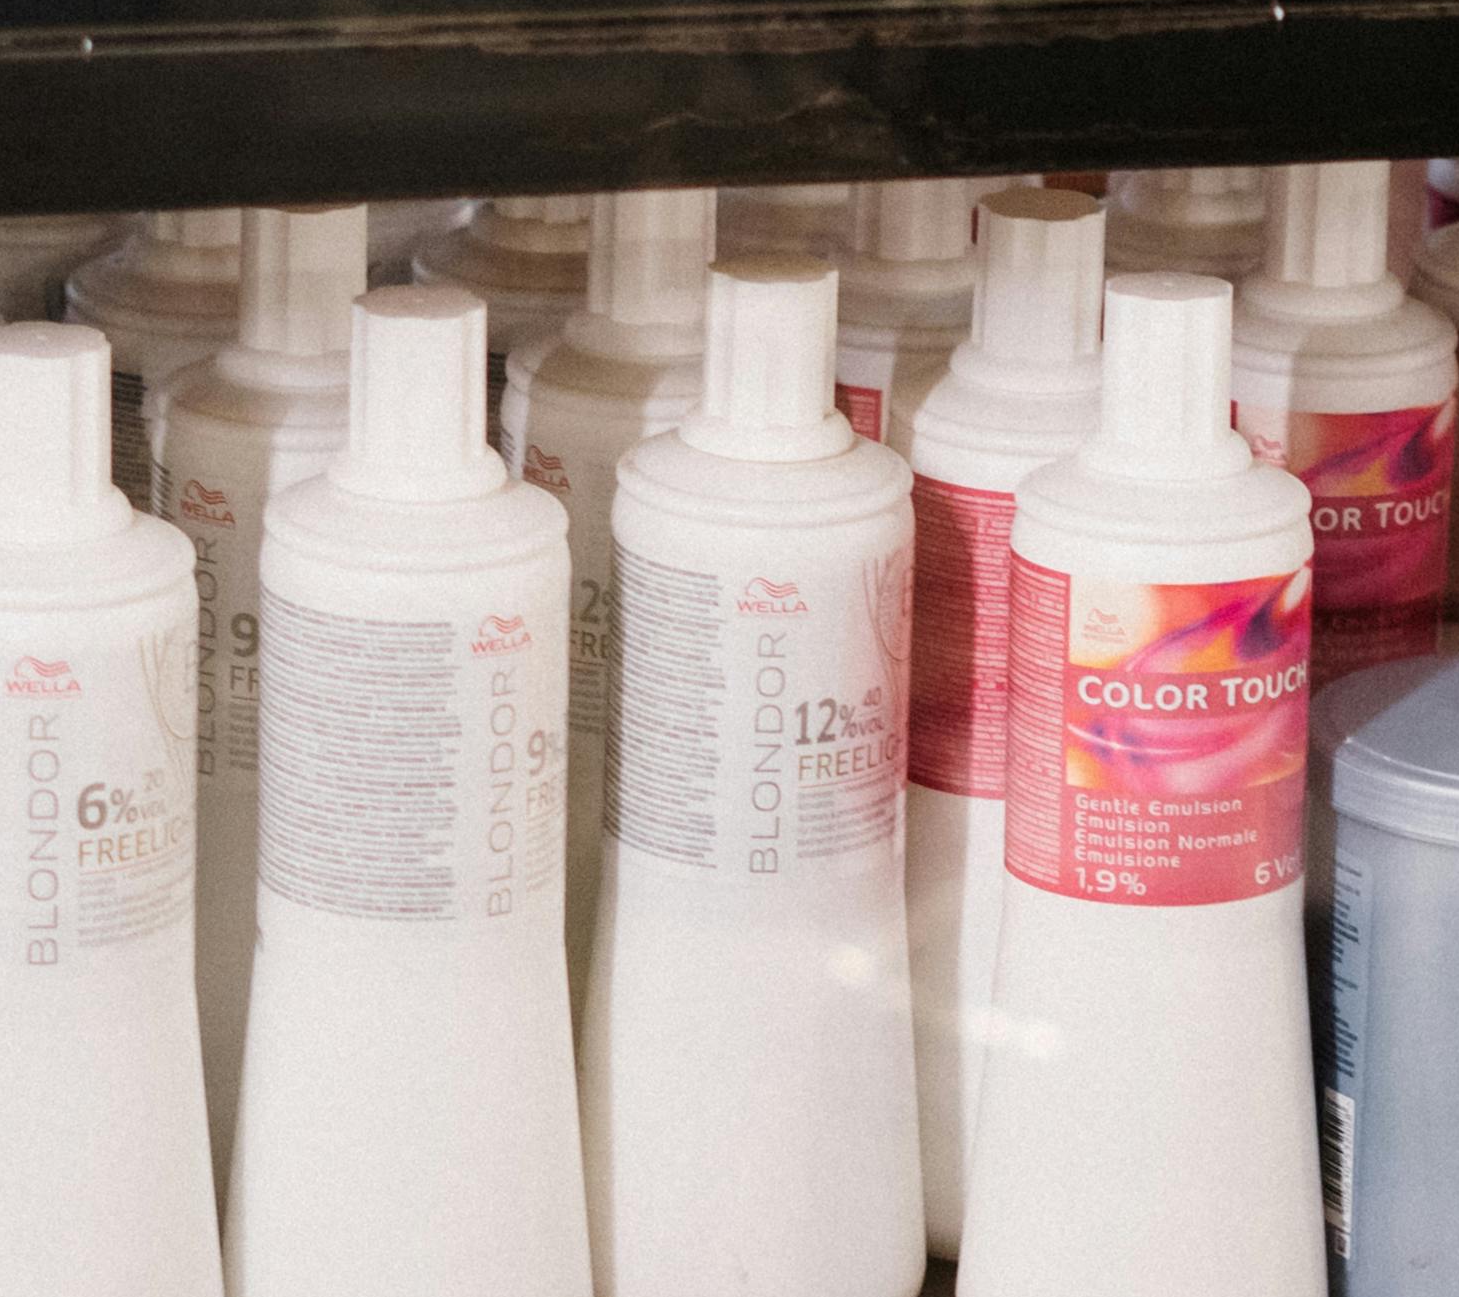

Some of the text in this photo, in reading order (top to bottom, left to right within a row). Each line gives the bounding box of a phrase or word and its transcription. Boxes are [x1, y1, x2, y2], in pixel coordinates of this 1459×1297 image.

[1375, 490, 1449, 529] TOUC
[736, 599, 809, 614] WELLA
[471, 632, 532, 654] WELLA
[5, 679, 82, 694] WELLA
[1077, 659, 1307, 712] COLOR TOUCH
[795, 698, 857, 746] 12%
[749, 632, 787, 874] BLONDOR
[77, 782, 139, 831] 6%
[488, 669, 516, 917] BLONDOR
[1075, 792, 1243, 816] Gentle Emulsion
[26, 713, 60, 966] BLONDOR
[1074, 811, 1171, 833] Emulsion
[1074, 828, 1259, 851] Emulsion Normale
[1074, 845, 1182, 869] Emulsione
[1074, 867, 1148, 897] 1,9%
[1254, 861, 1272, 885] 6
